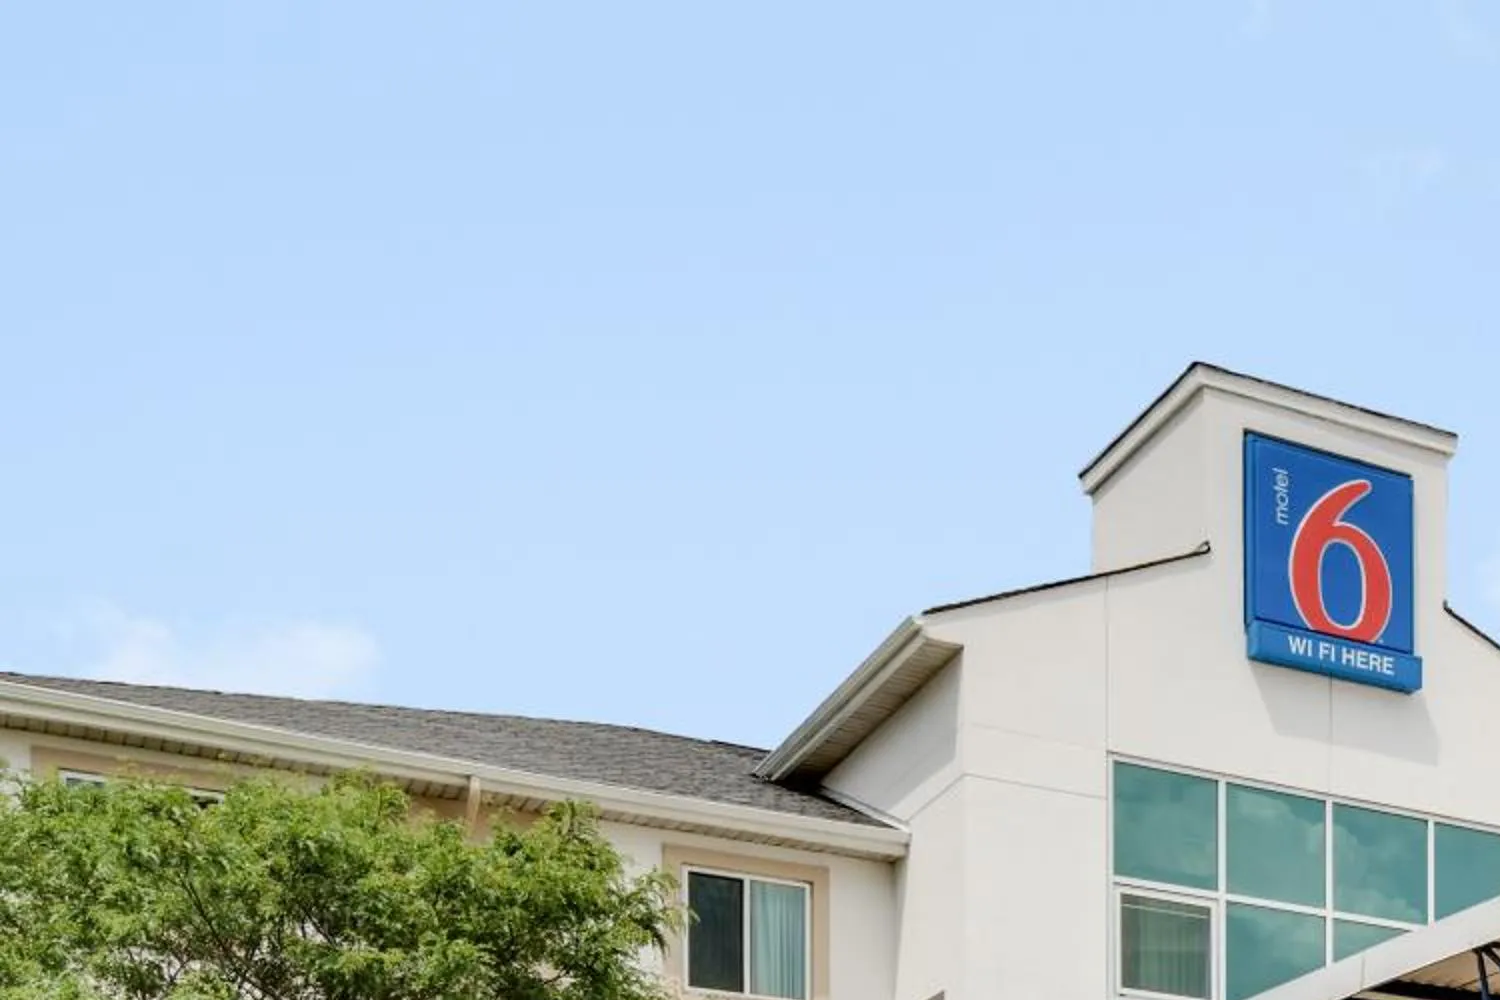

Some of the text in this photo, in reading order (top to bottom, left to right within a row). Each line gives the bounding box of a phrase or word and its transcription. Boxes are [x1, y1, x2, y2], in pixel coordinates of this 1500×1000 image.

[1272, 467, 1289, 525] motel
[1288, 479, 1393, 643] 6
[1288, 635, 1396, 676] WI FI HERE
